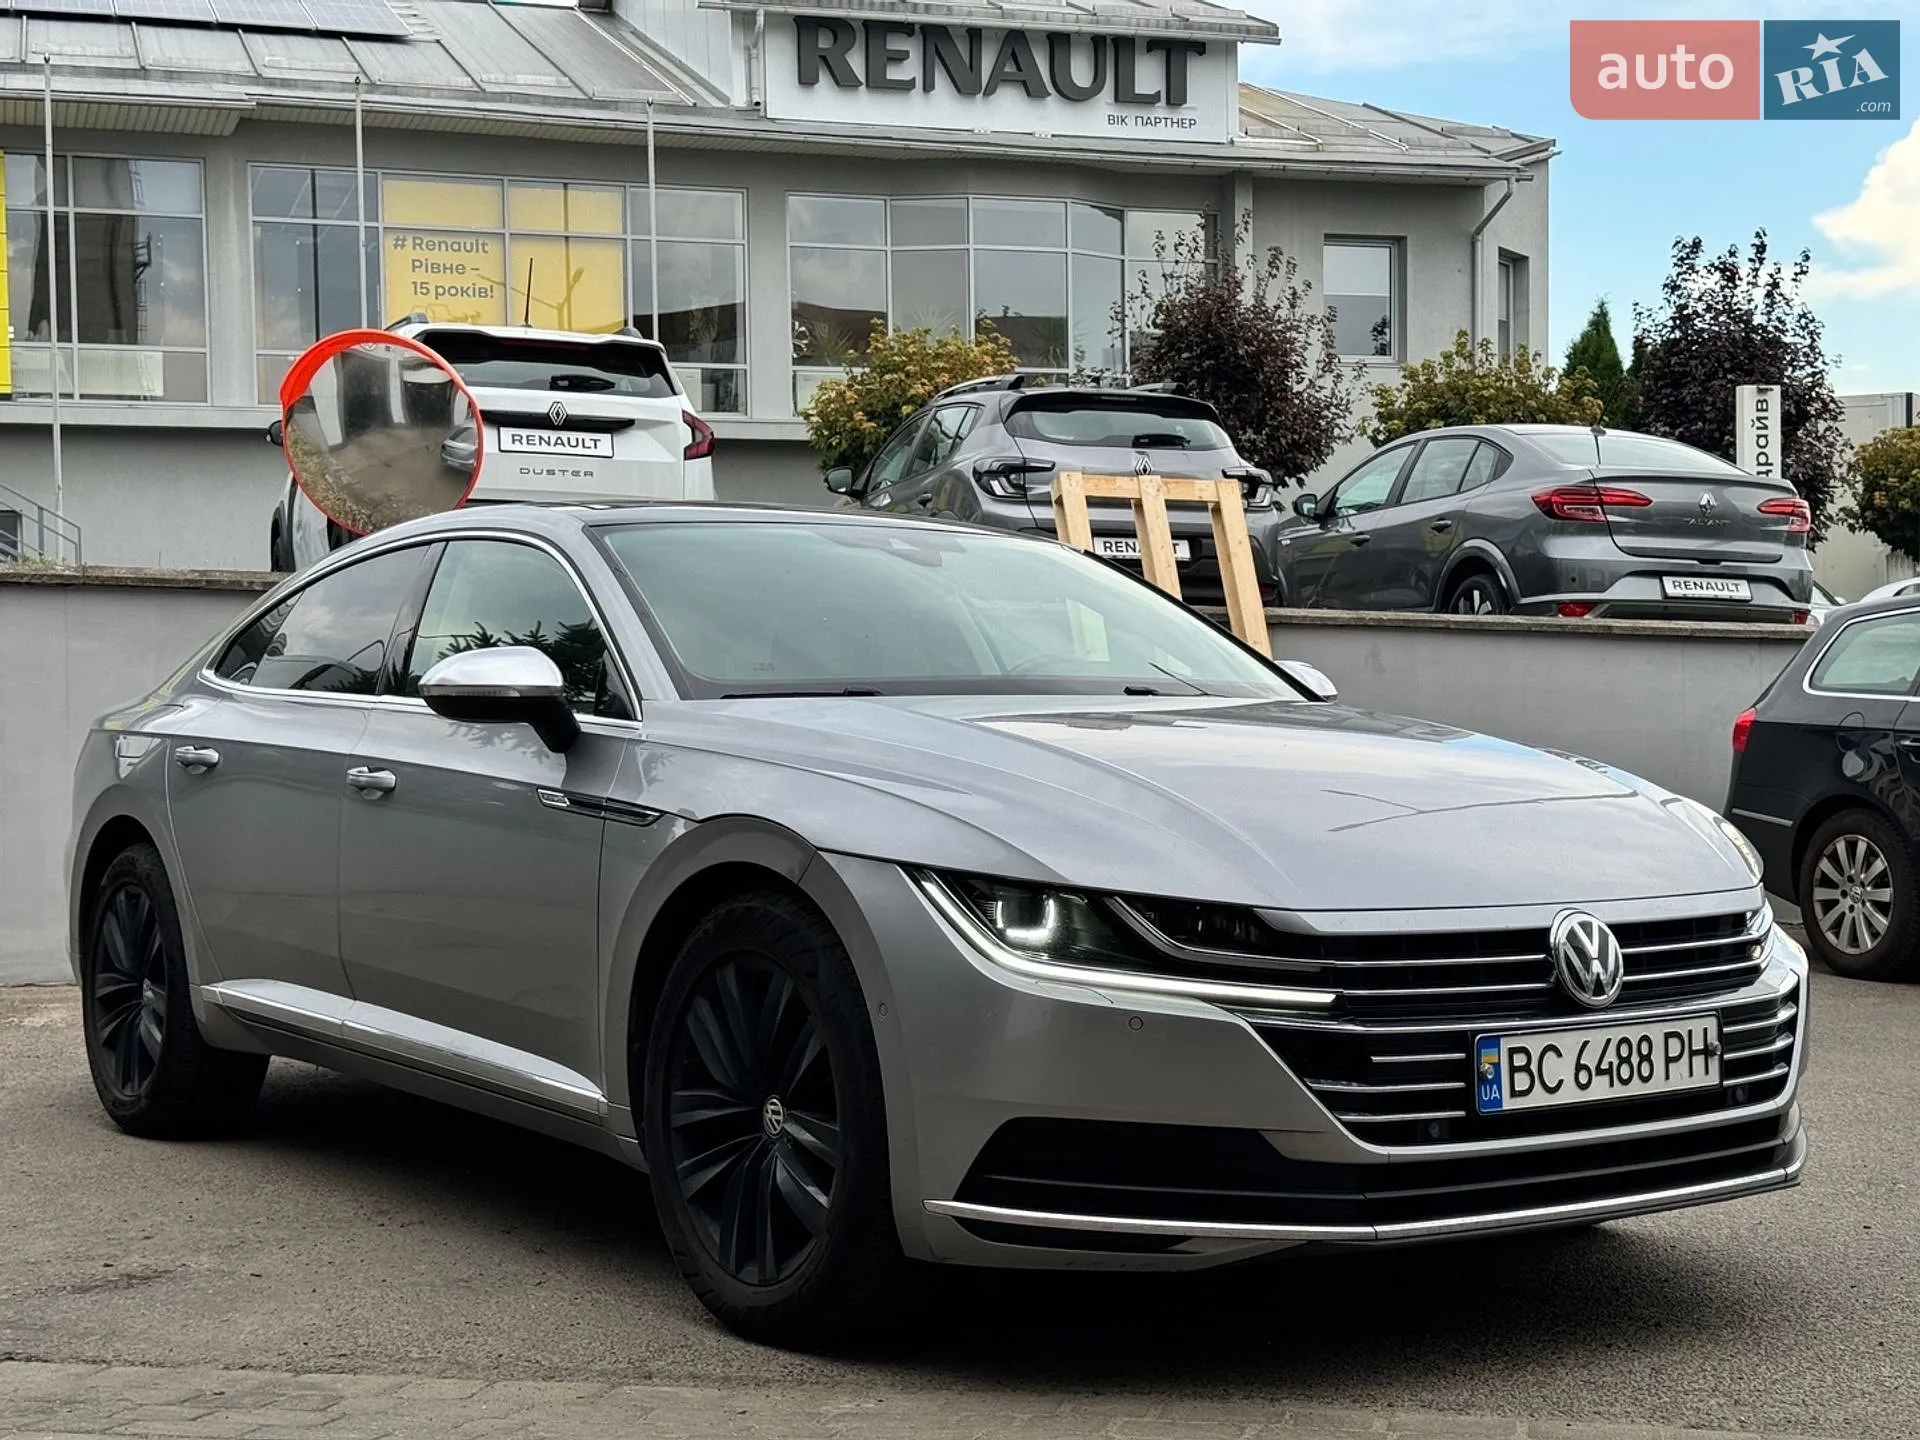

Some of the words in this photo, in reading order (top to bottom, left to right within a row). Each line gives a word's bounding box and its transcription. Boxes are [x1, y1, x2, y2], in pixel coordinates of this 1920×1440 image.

[793, 15, 1206, 107] RENAULT
[1107, 113, 1129, 127] ВІК
[1134, 115, 1198, 130] ПАРТНЕР
[412, 236, 489, 254] Renault
[411, 258, 467, 275] Рівне
[411, 281, 430, 296] 15
[434, 282, 495, 300] років!
[510, 433, 602, 450] RENAULT
[519, 467, 594, 478] DUSTER
[1103, 541, 1180, 554] RENT
[1672, 580, 1741, 593] RENAULT
[1507, 1043, 1564, 1098] BC
[1574, 1034, 1654, 1091] 6488
[1663, 1027, 1710, 1081] PH
[1481, 1085, 1500, 1101] UA
